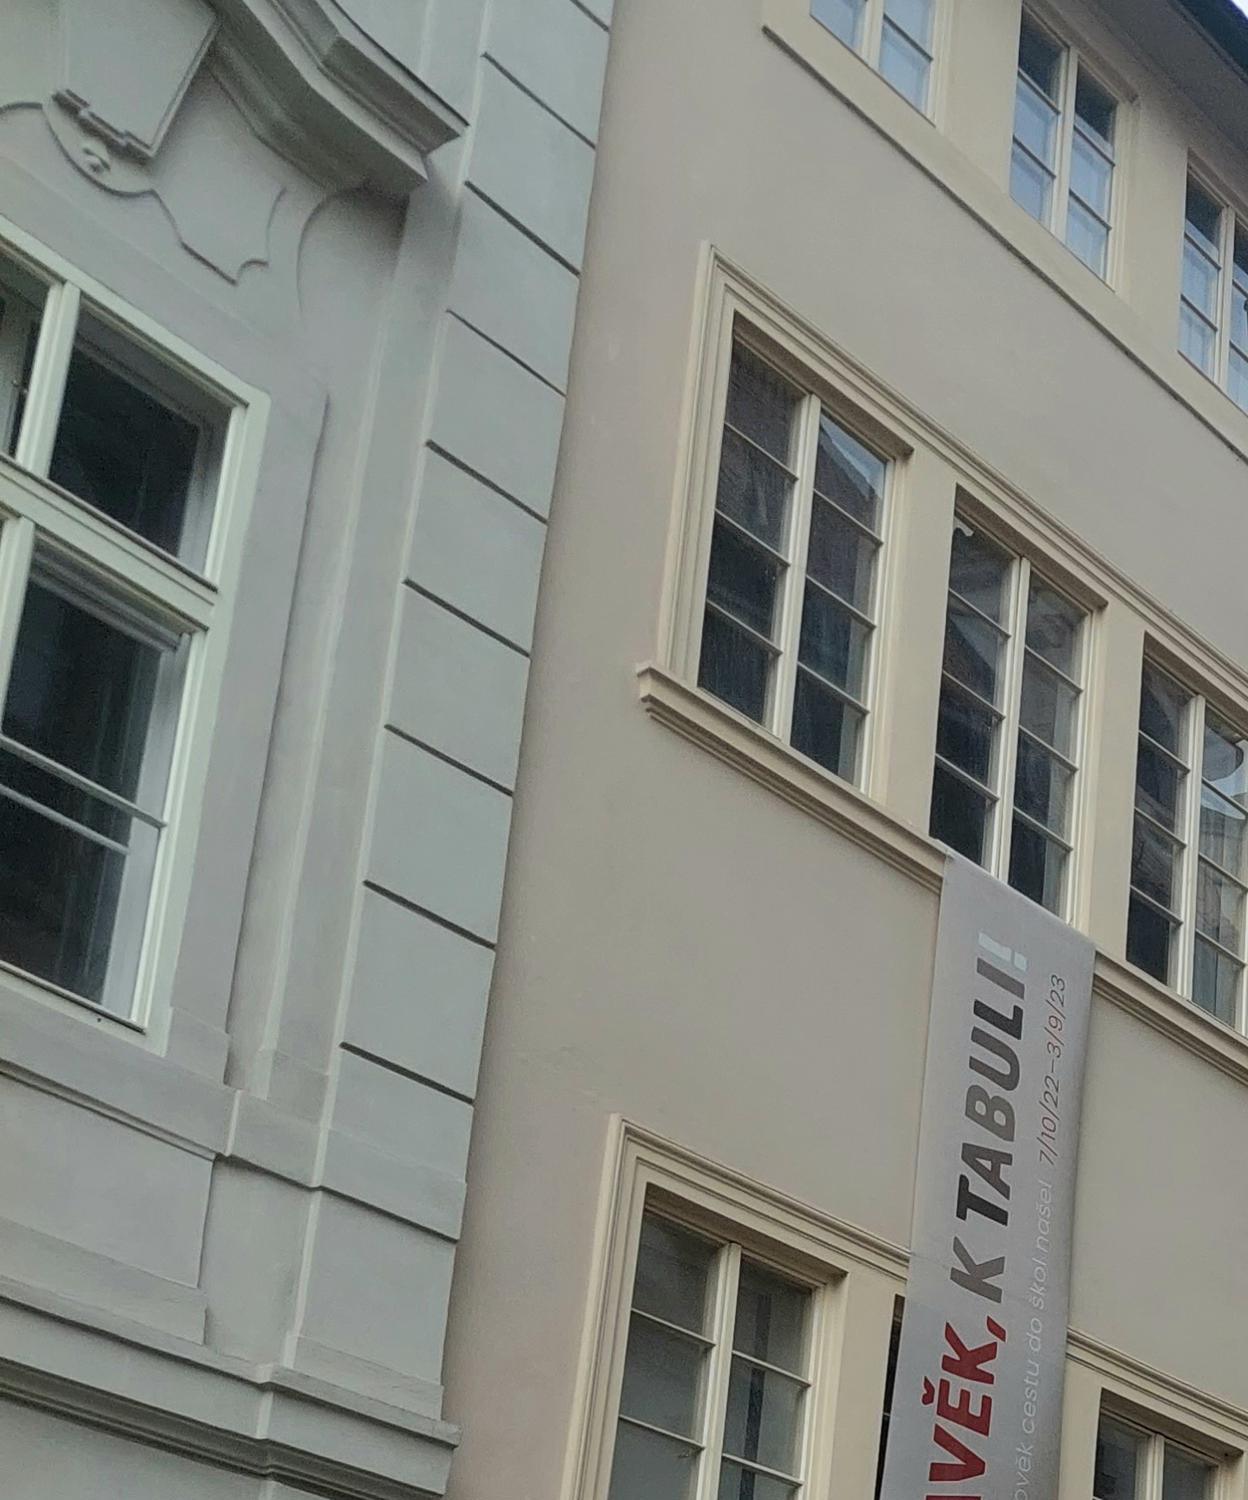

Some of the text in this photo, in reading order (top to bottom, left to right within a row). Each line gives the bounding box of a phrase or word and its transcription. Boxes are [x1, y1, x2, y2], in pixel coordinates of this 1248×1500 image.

[956, 931, 1028, 1227] TABULI!
[1034, 1178, 1054, 1251] našel
[950, 1234, 1005, 1303] K
[1028, 1255, 1047, 1310] škol
[1027, 1317, 1044, 1352] do
[1021, 1360, 1042, 1434] cestu
